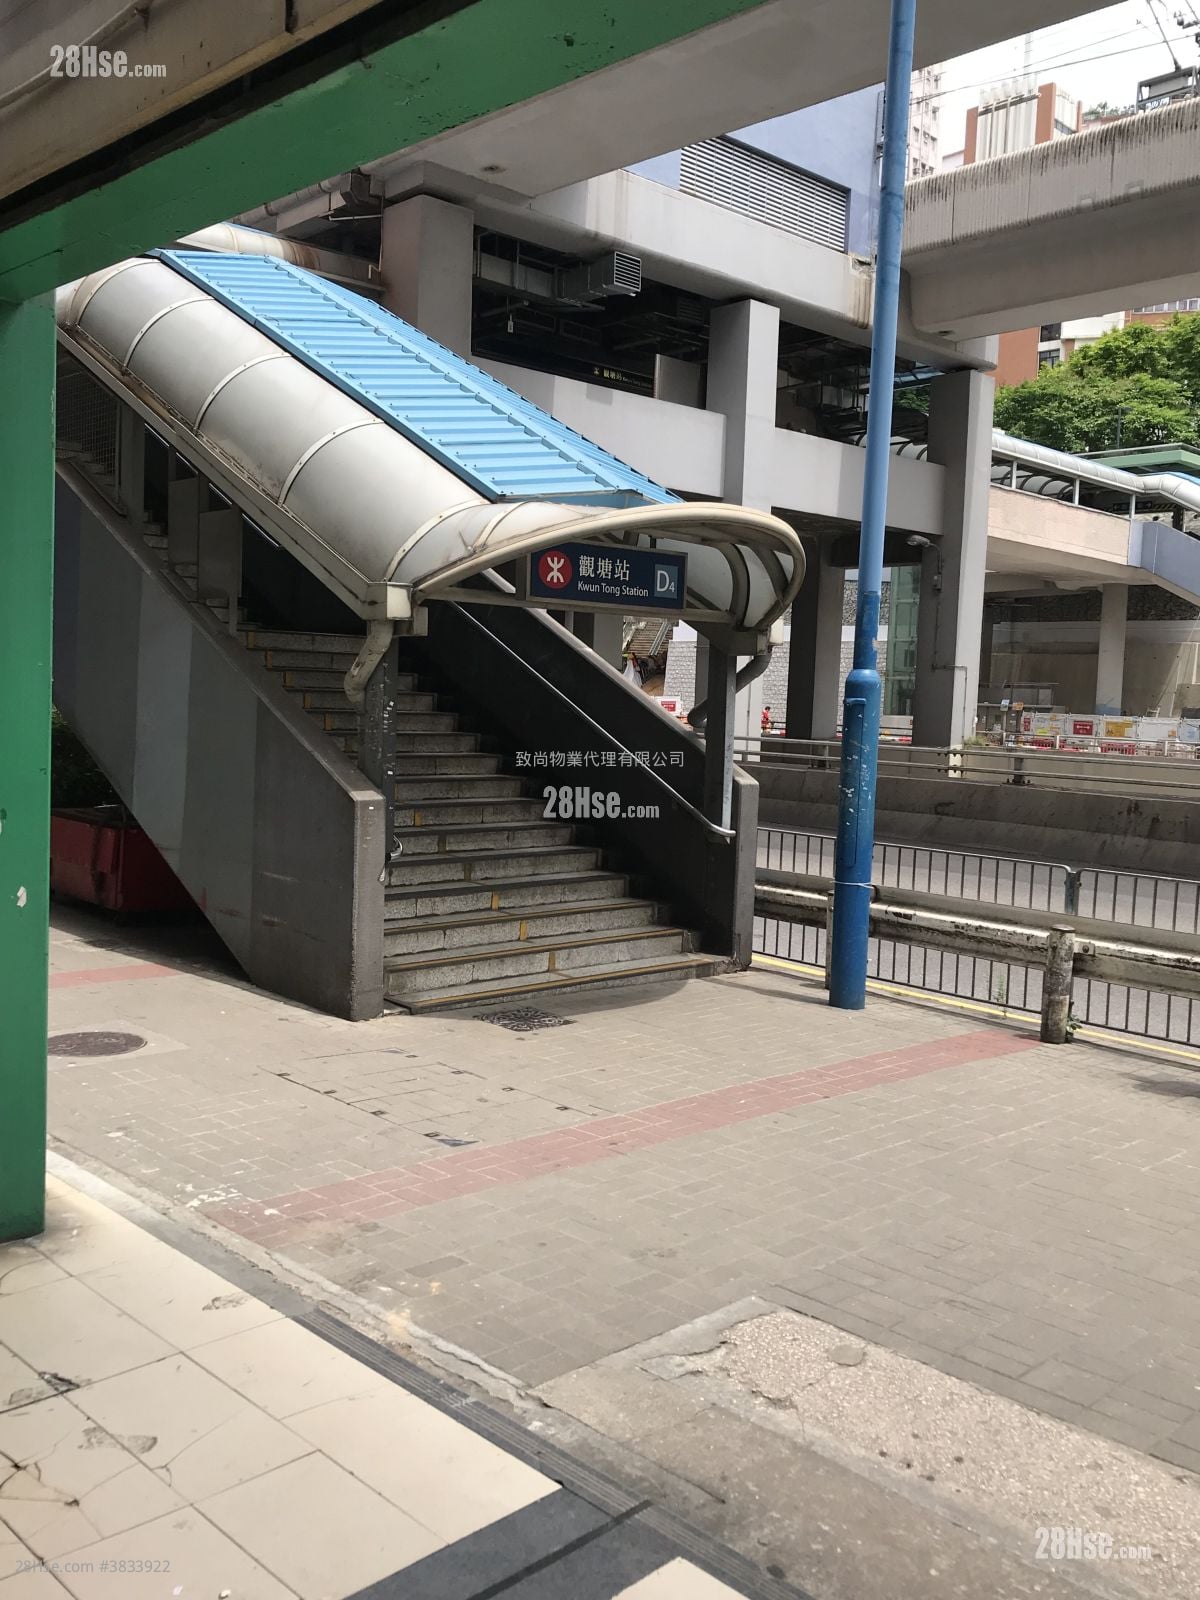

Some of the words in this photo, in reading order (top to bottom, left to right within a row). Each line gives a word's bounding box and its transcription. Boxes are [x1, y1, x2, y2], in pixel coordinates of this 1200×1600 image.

[579, 555, 630, 581] 觀塘站
[578, 581, 600, 593] Kwun
[601, 583, 621, 596] Tong
[622, 585, 649, 597] Station
[656, 570, 675, 592] D4
